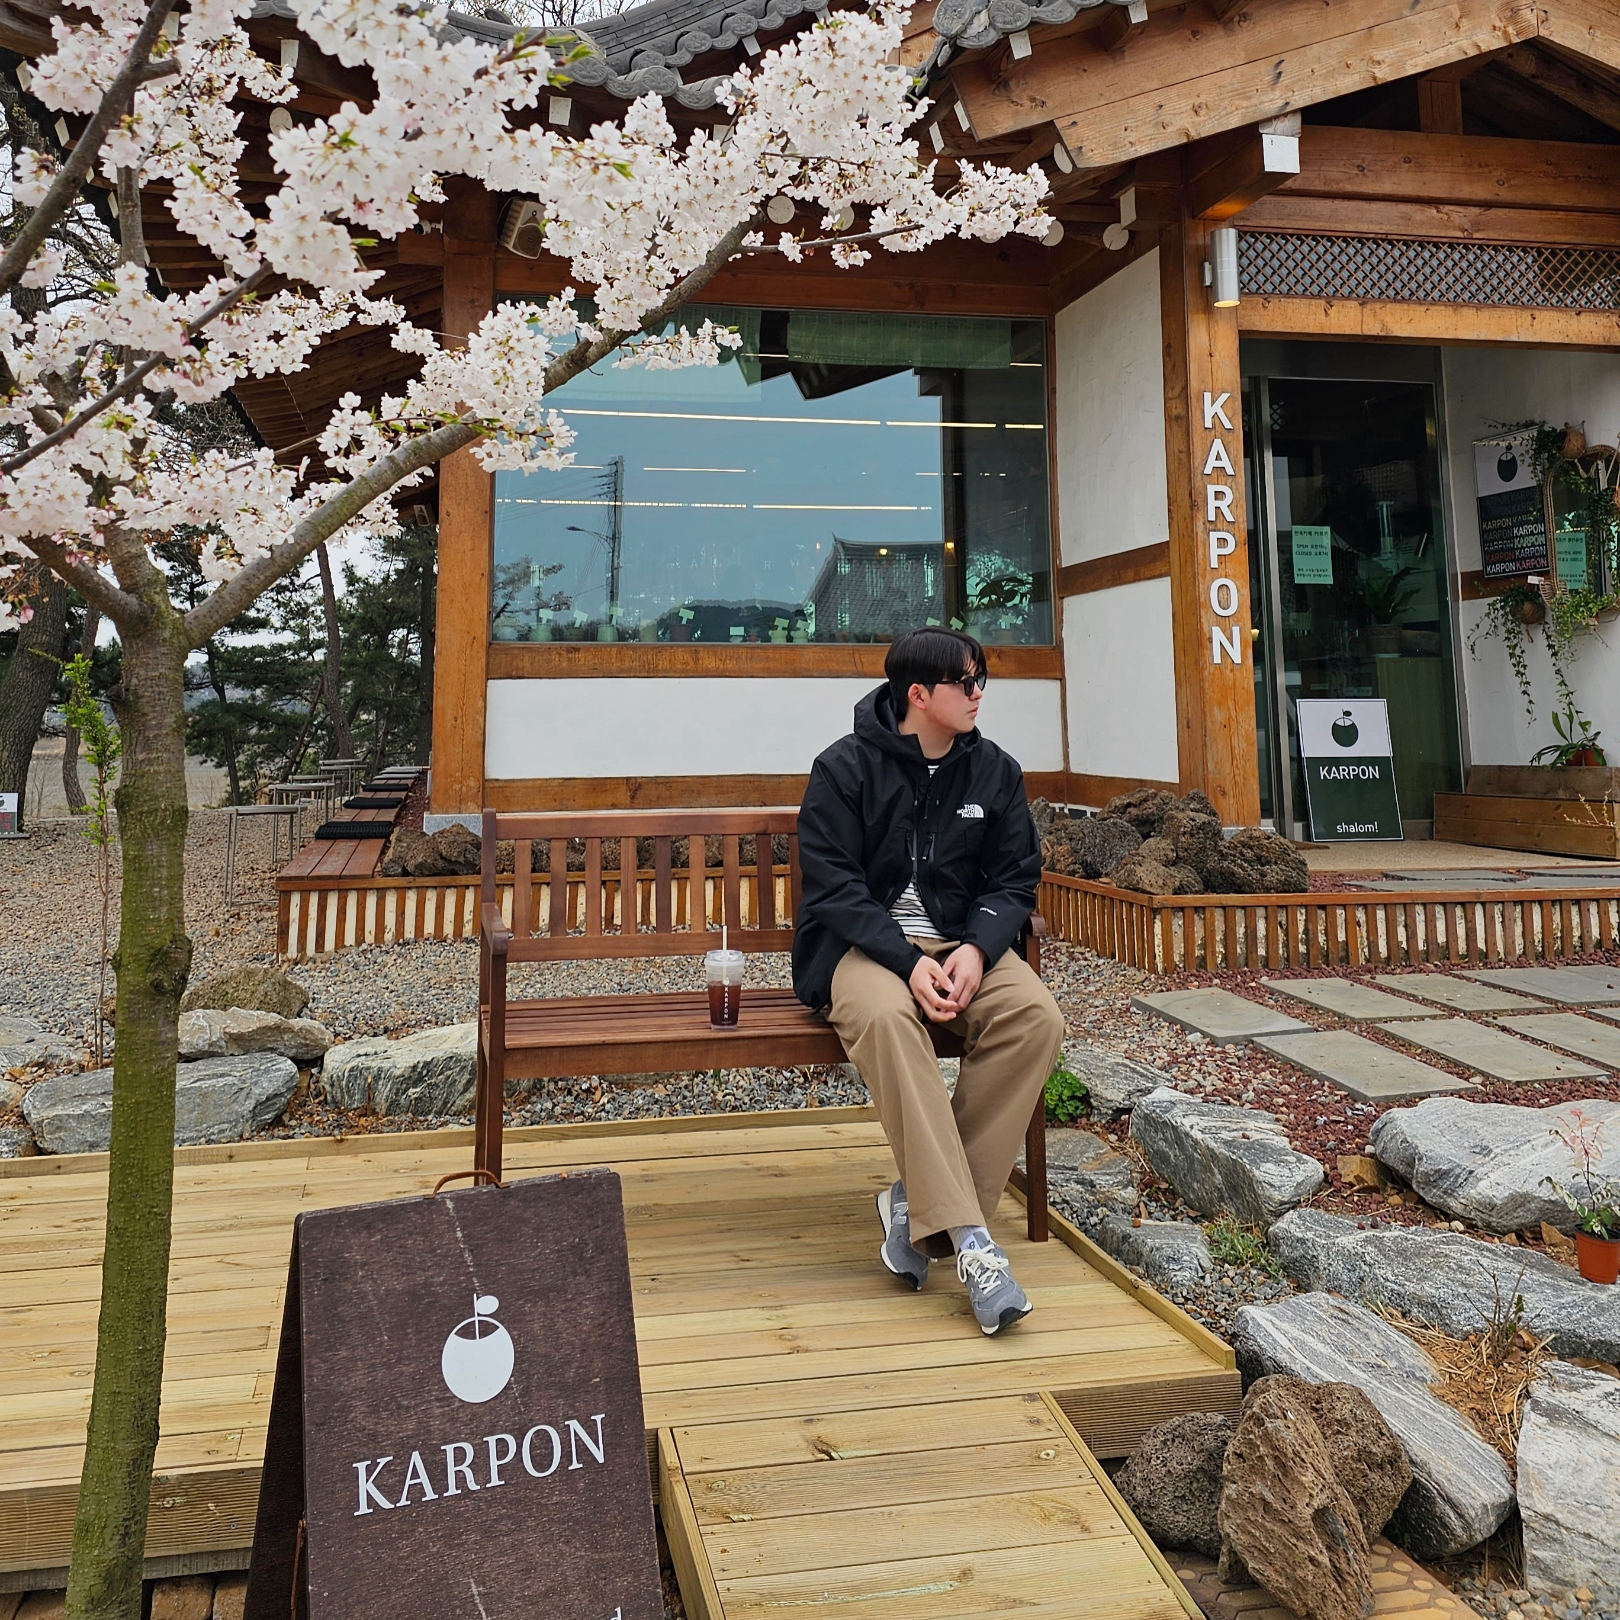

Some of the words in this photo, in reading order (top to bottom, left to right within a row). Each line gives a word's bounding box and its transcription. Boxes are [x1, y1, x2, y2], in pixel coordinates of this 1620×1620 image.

[1203, 391, 1242, 664] KARPON
[1483, 518, 1512, 530] KARPON
[1513, 523, 1544, 537] KARPON
[1514, 535, 1545, 548] KARPON
[1515, 546, 1546, 558] KARPON
[1486, 562, 1515, 574] KARPON
[1516, 558, 1547, 570] KARPON
[1319, 765, 1380, 780] KARPON
[1336, 821, 1379, 833] shalom!
[352, 1413, 606, 1517] KARPON
